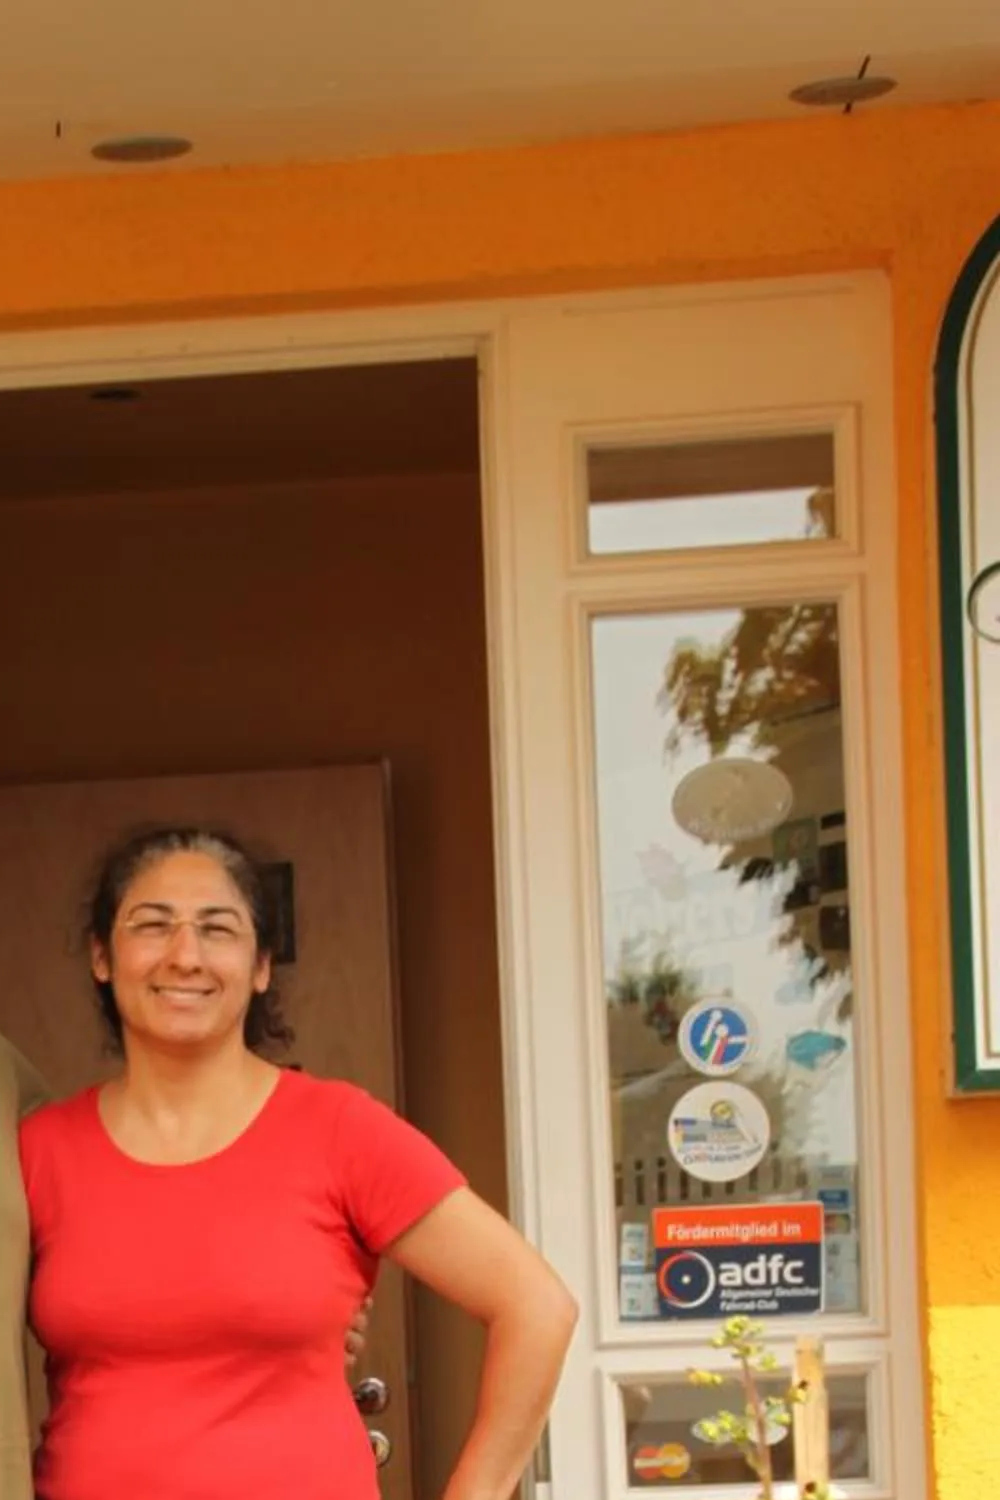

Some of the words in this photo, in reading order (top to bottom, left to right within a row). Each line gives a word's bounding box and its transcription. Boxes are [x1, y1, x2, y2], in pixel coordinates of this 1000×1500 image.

[667, 1221, 778, 1242] Fördermitglied
[782, 1220, 801, 1237] im
[718, 1253, 804, 1286] adfc
